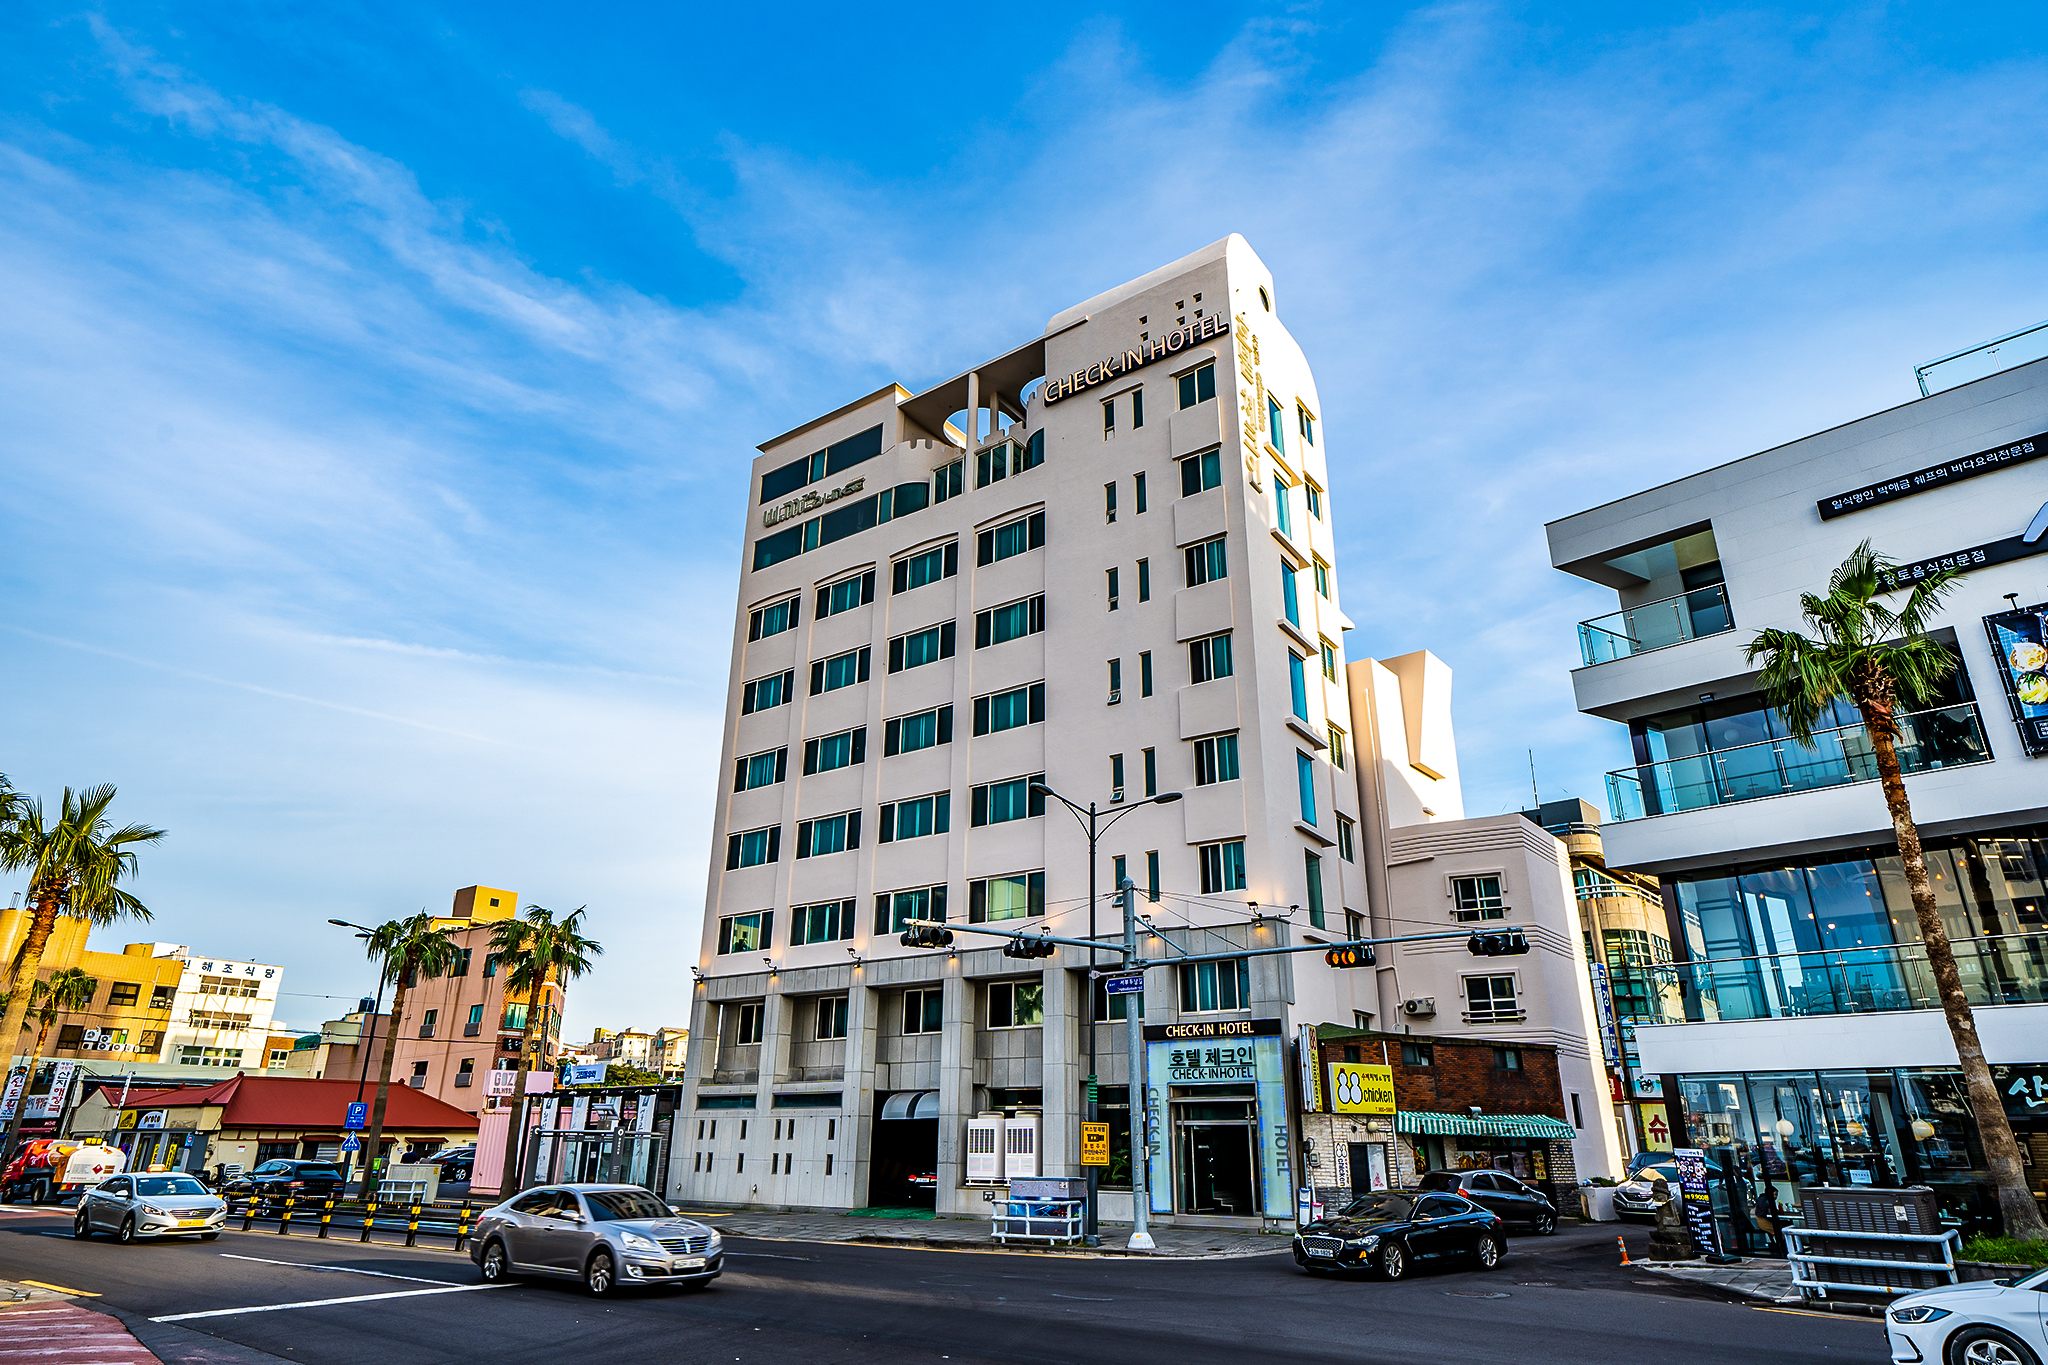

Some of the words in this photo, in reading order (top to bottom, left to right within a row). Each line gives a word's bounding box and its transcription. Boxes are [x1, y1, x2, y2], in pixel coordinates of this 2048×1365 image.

[1044, 344, 1144, 402] CHECK-IN
[1150, 312, 1228, 360] HOTEL
[1950, 441, 2035, 473] 바다요리전문점
[1166, 1024, 1214, 1037] CHECK-IN
[1219, 1022, 1254, 1034] HOTEL
[1170, 1048, 1200, 1067] 호텔
[1205, 1046, 1253, 1066] 체크인
[1363, 1088, 1393, 1103] chicken
[144, 1114, 160, 1124] proto
[1148, 1087, 1160, 1156] CHECK-IN
[1648, 1114, 1669, 1143] 슈
[1274, 1125, 1290, 1177] HOTEL
